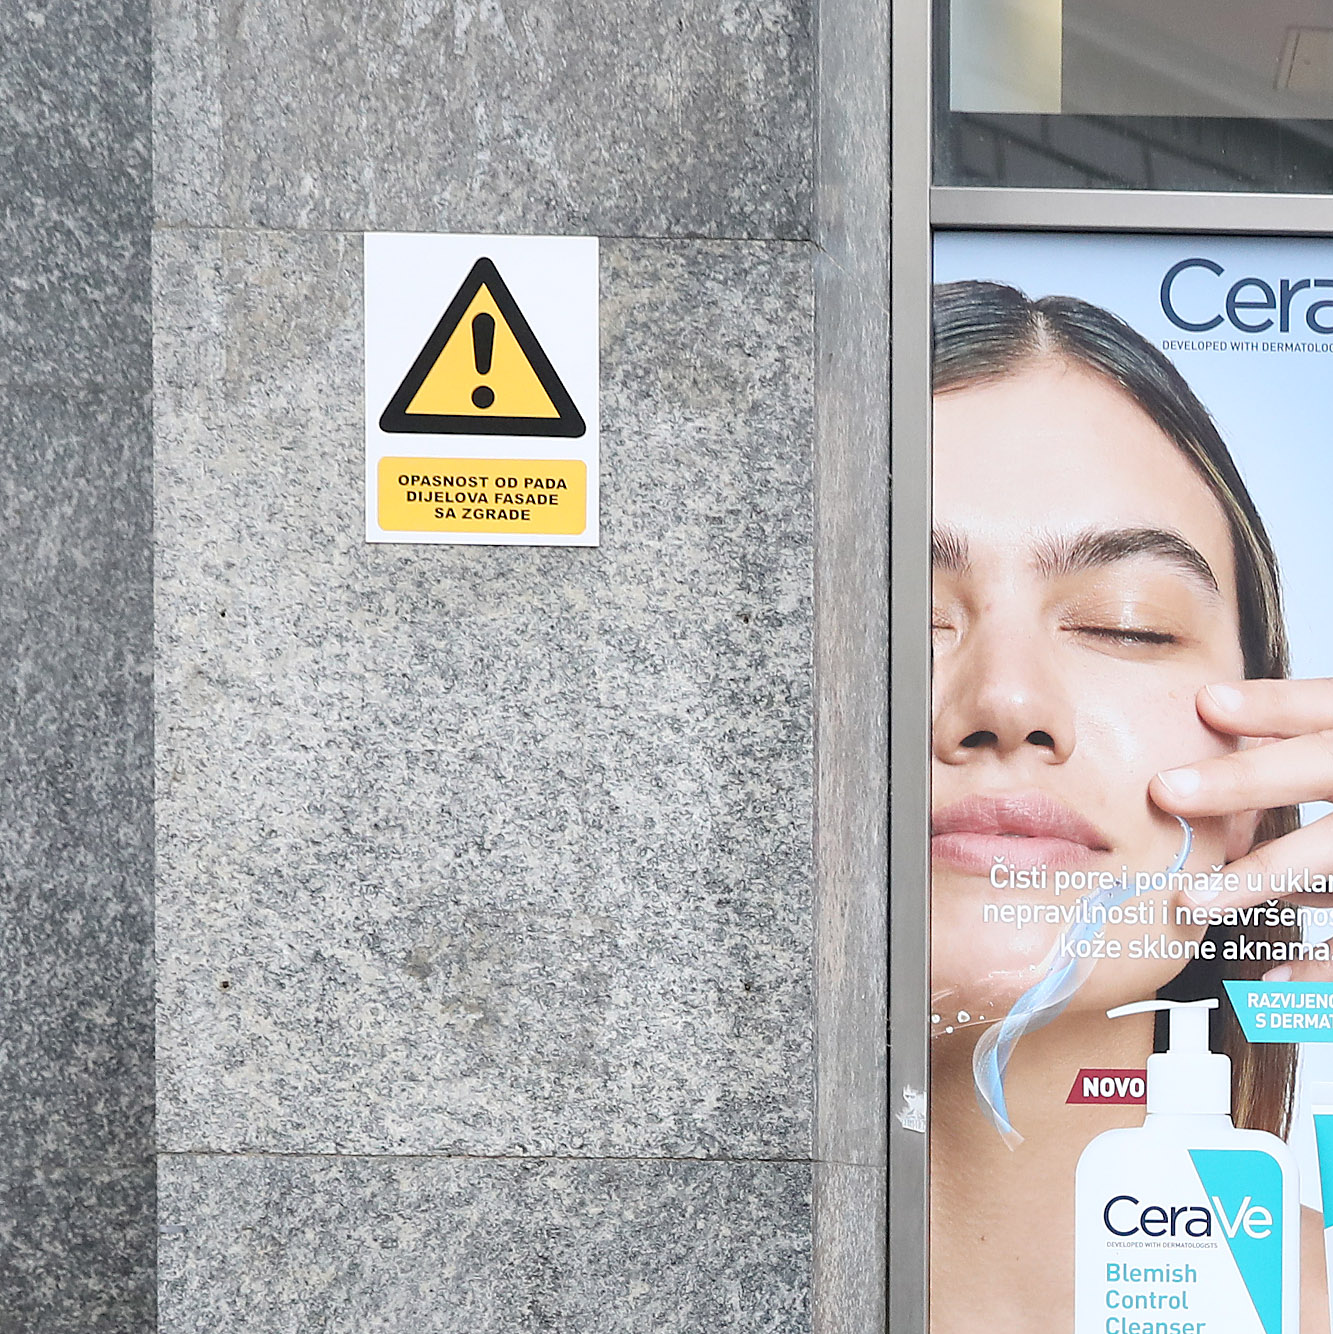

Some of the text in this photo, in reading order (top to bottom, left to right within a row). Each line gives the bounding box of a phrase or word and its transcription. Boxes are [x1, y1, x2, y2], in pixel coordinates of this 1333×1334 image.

[1162, 340, 1228, 351] DEVELOPED
[1230, 342, 1259, 352] WITH
[398, 475, 568, 490] OPASNOST OD PADA
[406, 491, 559, 506] DIJELOVA FASADE
[434, 508, 531, 521] SA ZGRADE
[990, 856, 1047, 890] Čisti
[1055, 870, 1114, 896] pore
[1122, 866, 1128, 890] i
[1135, 864, 1240, 896] pomaže
[1247, 873, 1262, 892] u
[983, 898, 1154, 930] nepravilnosti
[1162, 899, 1168, 924] i
[1060, 932, 1122, 959] kože
[1128, 934, 1216, 960] sklone
[1255, 1013, 1267, 1028] S
[1082, 1076, 1146, 1099] NOVO
[1103, 1195, 1273, 1239] CeraVe
[1106, 1263, 1197, 1283] Blemish
[1105, 1290, 1189, 1310] Control
